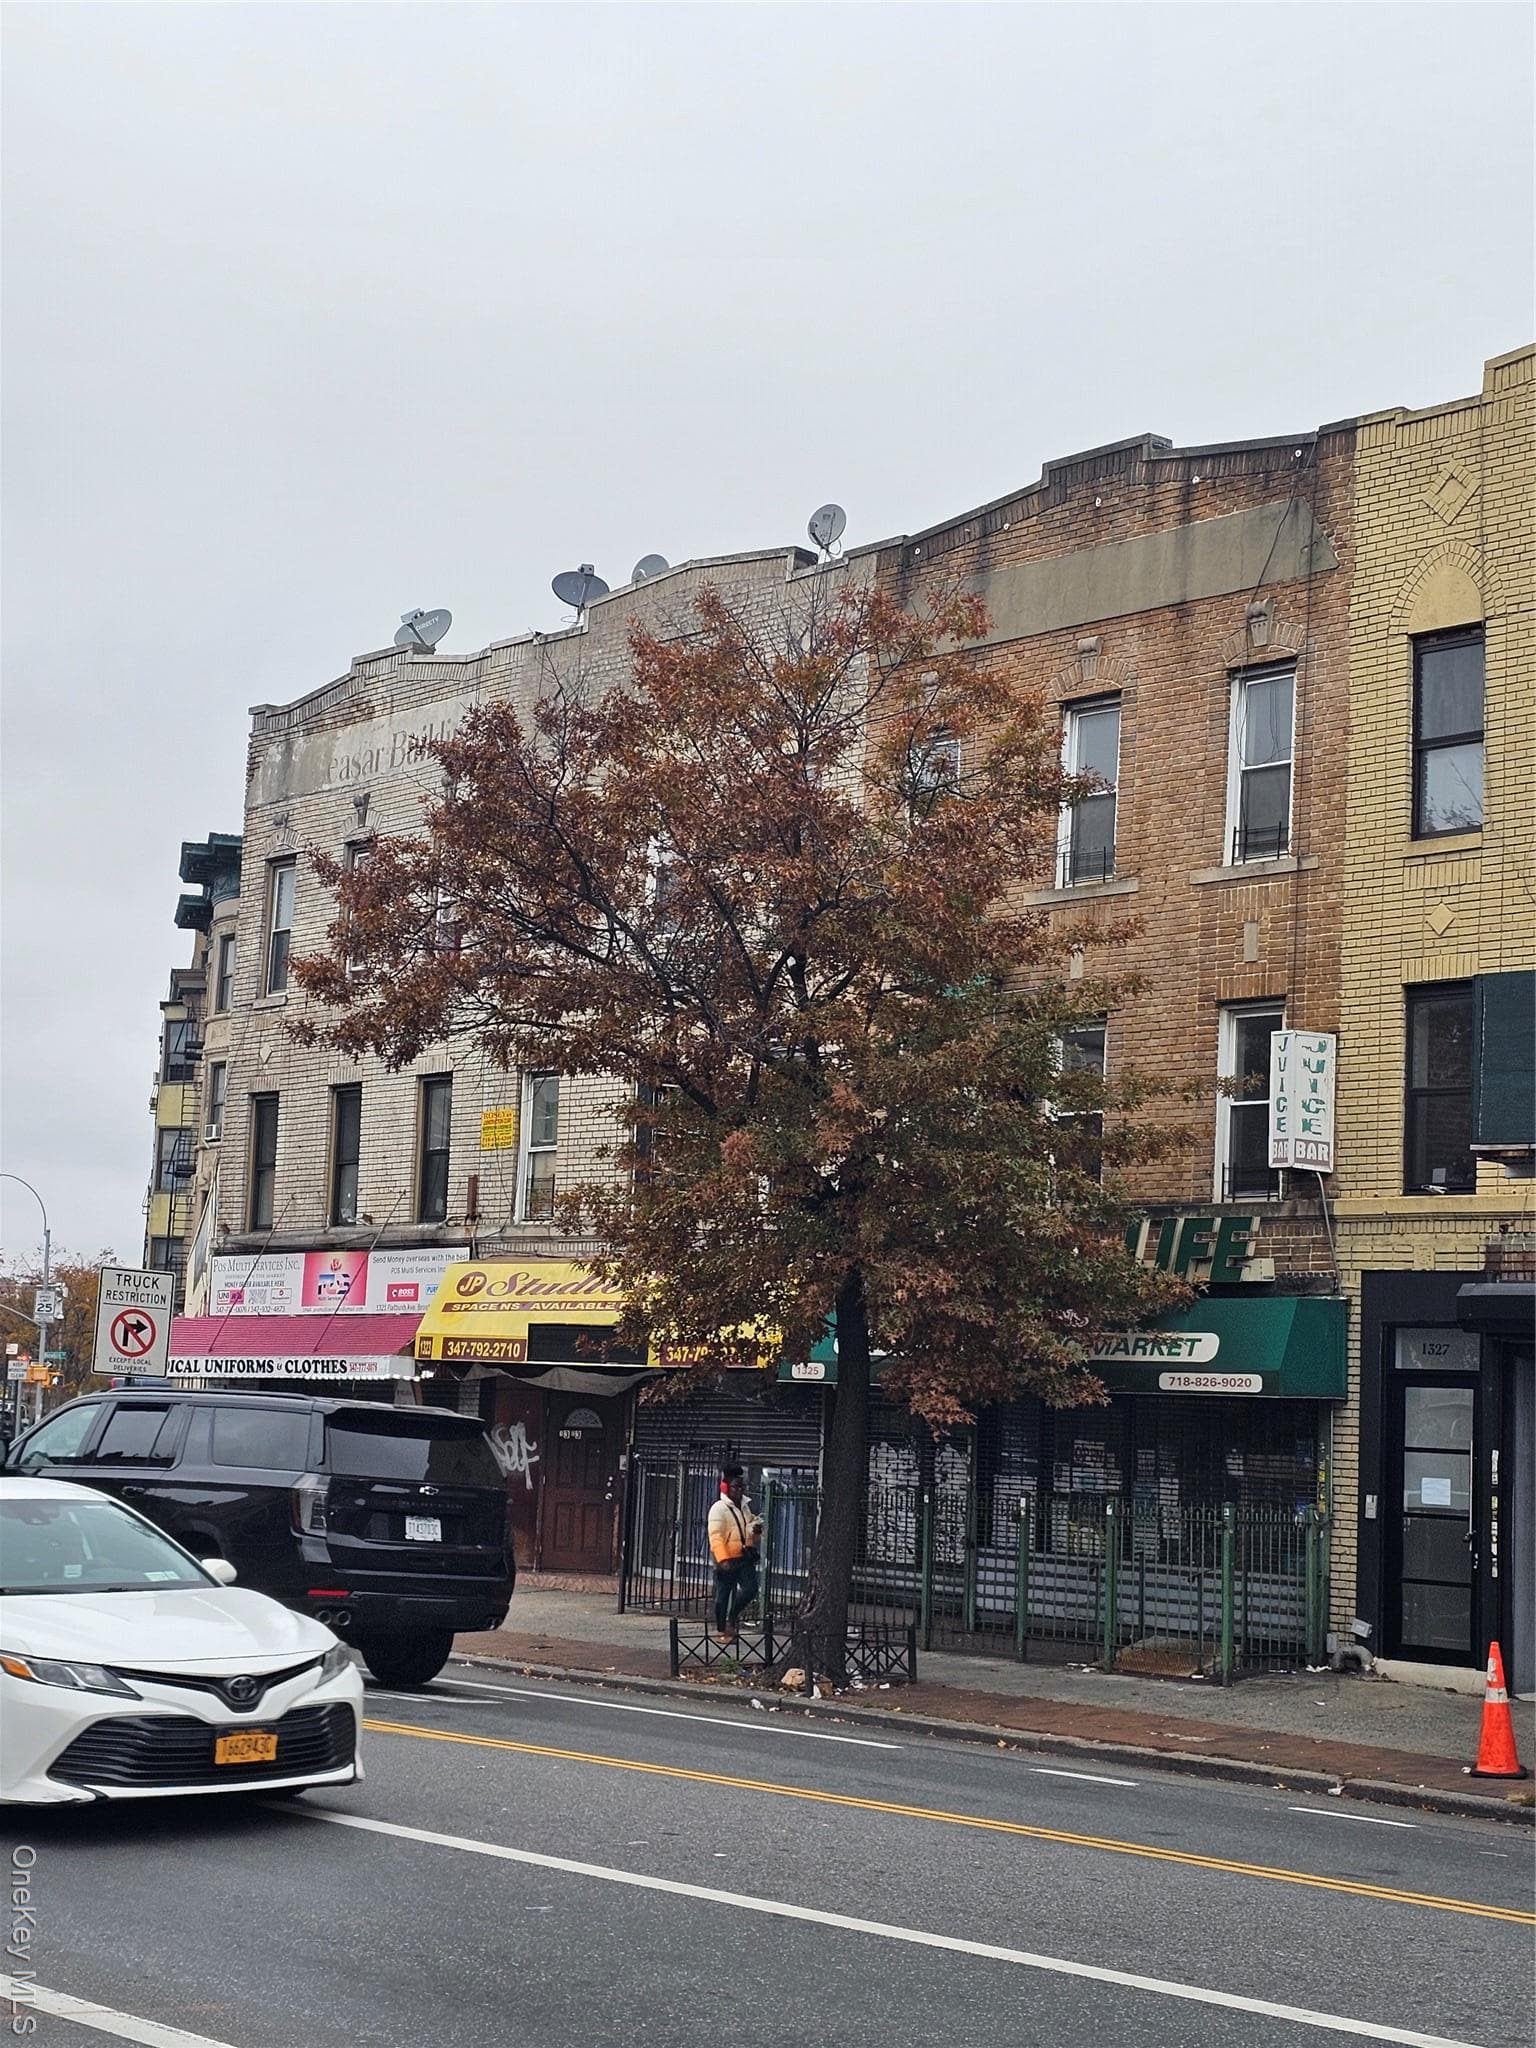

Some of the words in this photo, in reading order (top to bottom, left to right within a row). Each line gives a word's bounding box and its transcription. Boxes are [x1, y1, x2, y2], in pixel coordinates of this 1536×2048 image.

[1273, 1141, 1288, 1159] BAR
[1295, 1140, 1329, 1161] BAR
[116, 1273, 160, 1290] TRUCK
[460, 1275, 484, 1292] JP
[105, 1290, 167, 1305] RESTRICTION
[37, 1303, 53, 1313] 25
[530, 1301, 616, 1311] AVAILABLE
[447, 1341, 521, 1357] 347-792-2710
[1423, 1343, 1450, 1356] 1327
[109, 1356, 131, 1366] EXCEPT
[132, 1358, 152, 1366] LOCAL
[167, 1359, 200, 1374] ICAL
[204, 1359, 274, 1374] UNIFORMS
[285, 1359, 348, 1374] CLOTHES
[113, 1364, 147, 1374] DELIVERIES
[797, 1366, 819, 1376] 1325
[1169, 1376, 1252, 1388] 718-826-9020
